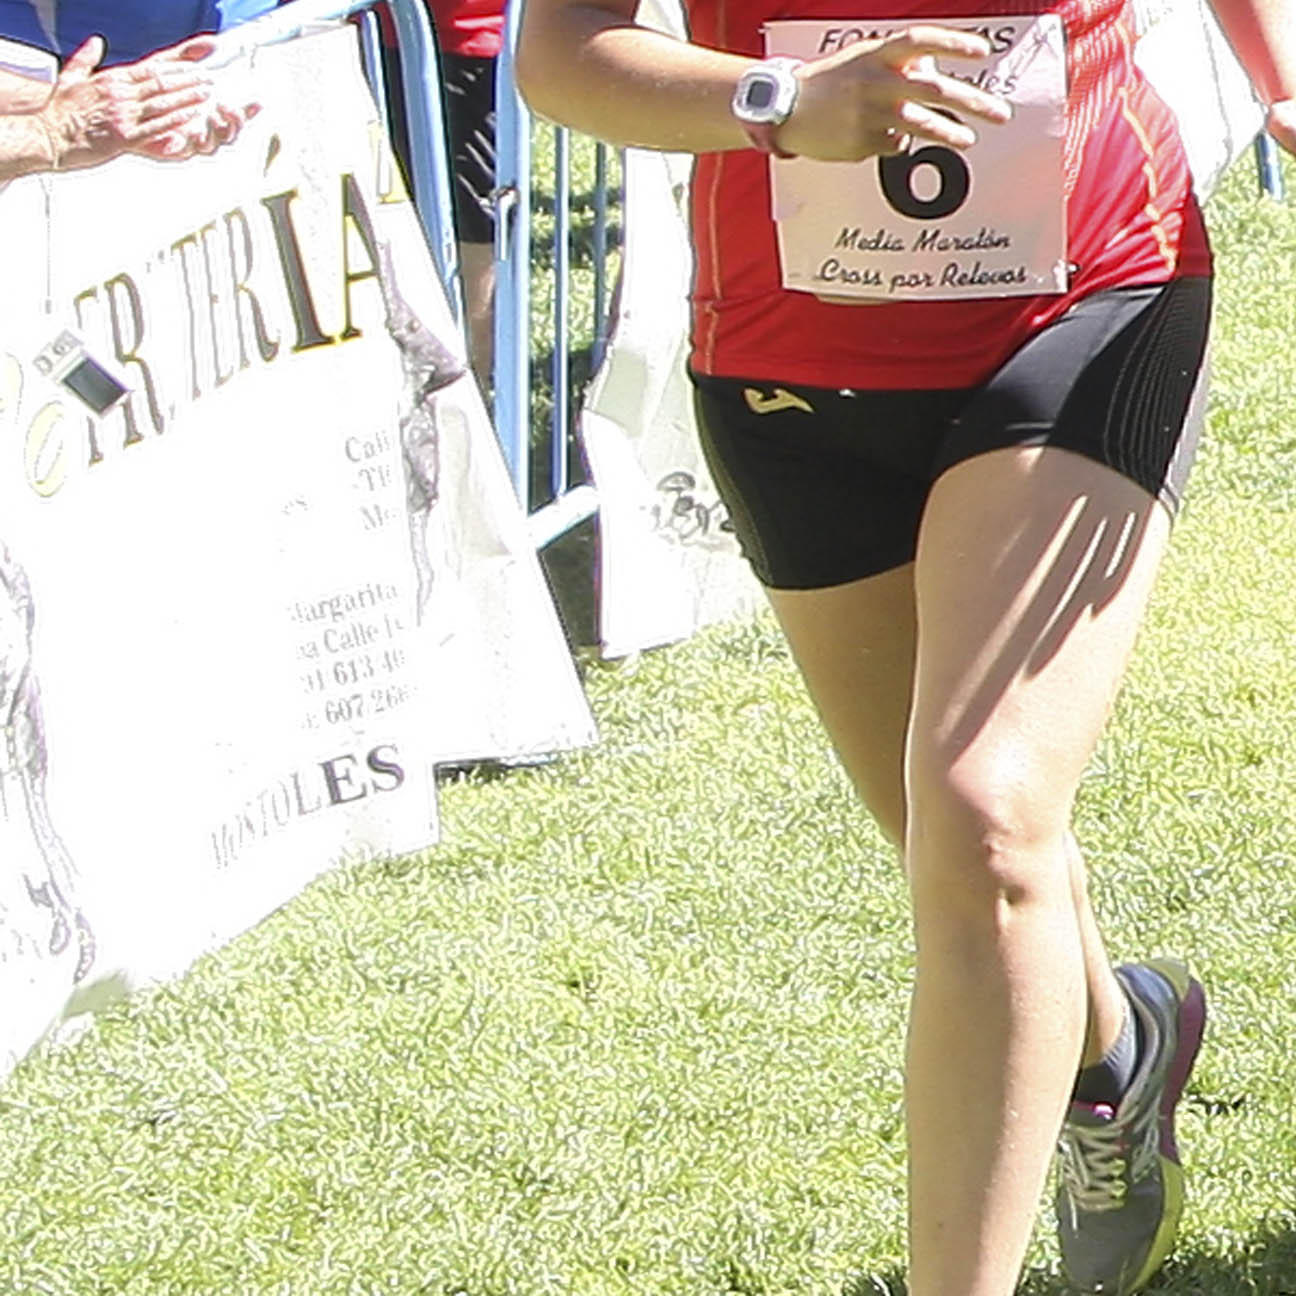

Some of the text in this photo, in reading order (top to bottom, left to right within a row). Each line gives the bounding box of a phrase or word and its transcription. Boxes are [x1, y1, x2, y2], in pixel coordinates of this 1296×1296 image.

[879, 106, 971, 219] 6
[819, 258, 1028, 291] Cross por Relevos
[835, 227, 906, 251] Media
[73, 133, 386, 467] RTERÍA
